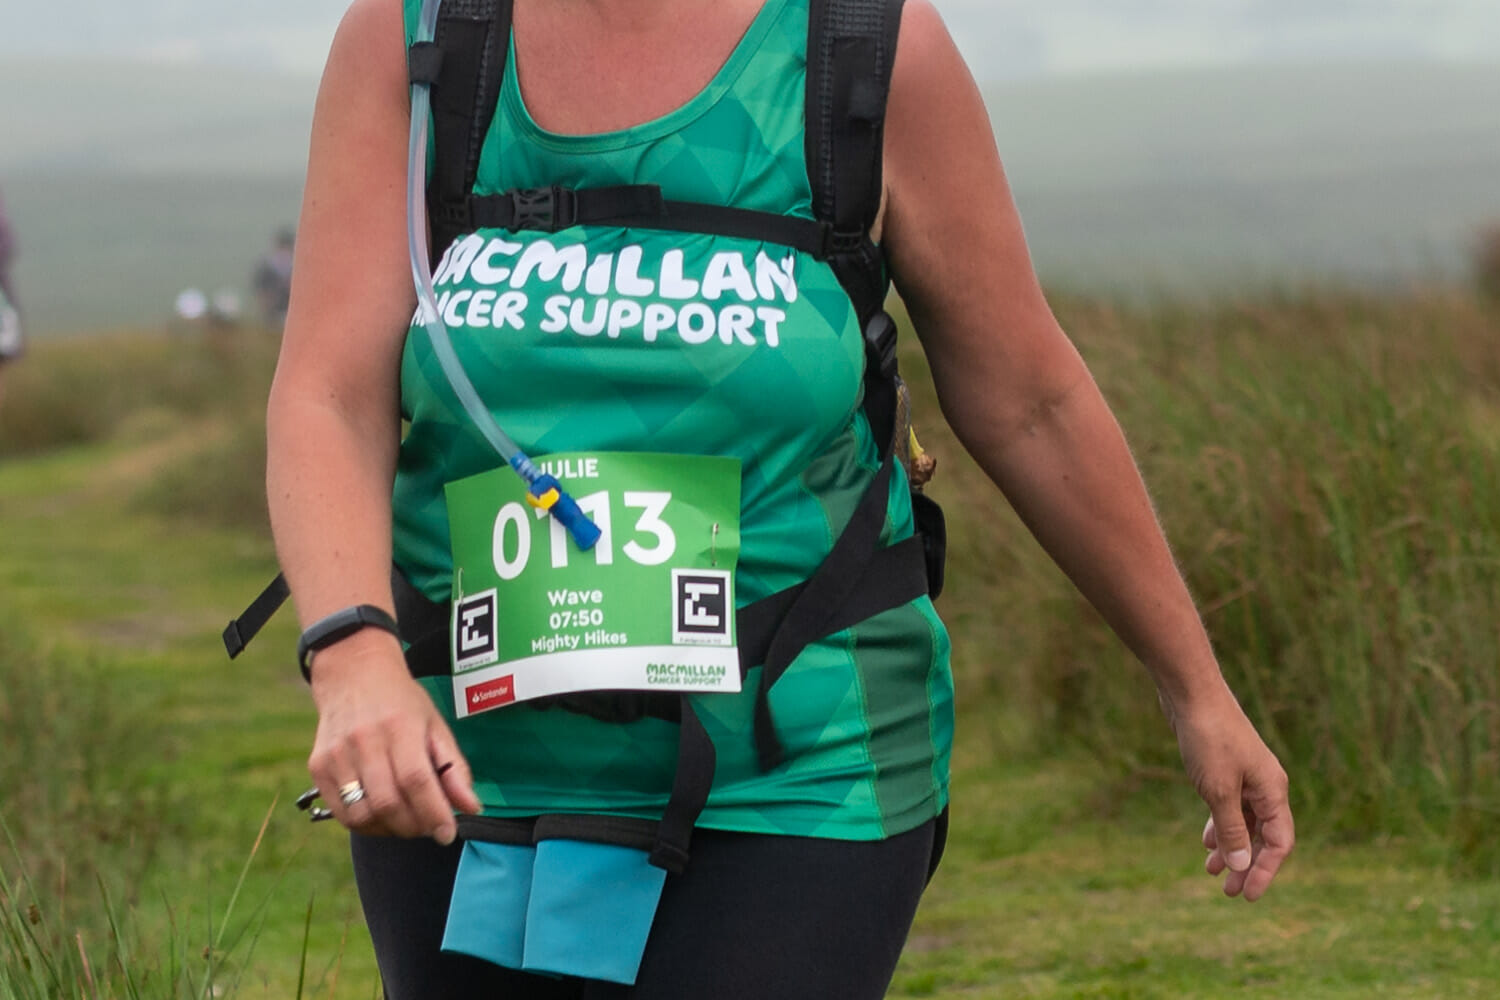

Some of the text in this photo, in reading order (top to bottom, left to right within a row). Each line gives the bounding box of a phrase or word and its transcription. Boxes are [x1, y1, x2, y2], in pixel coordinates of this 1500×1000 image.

[539, 295, 786, 347] SUPPORT
[492, 490, 676, 580] 0113
[548, 589, 603, 606] Wave
[550, 609, 603, 629] 07:50
[532, 630, 627, 653] Mighty Hikes
[646, 663, 726, 676] MACMILLAN
[648, 676, 722, 685] CANCER SUPPORT
